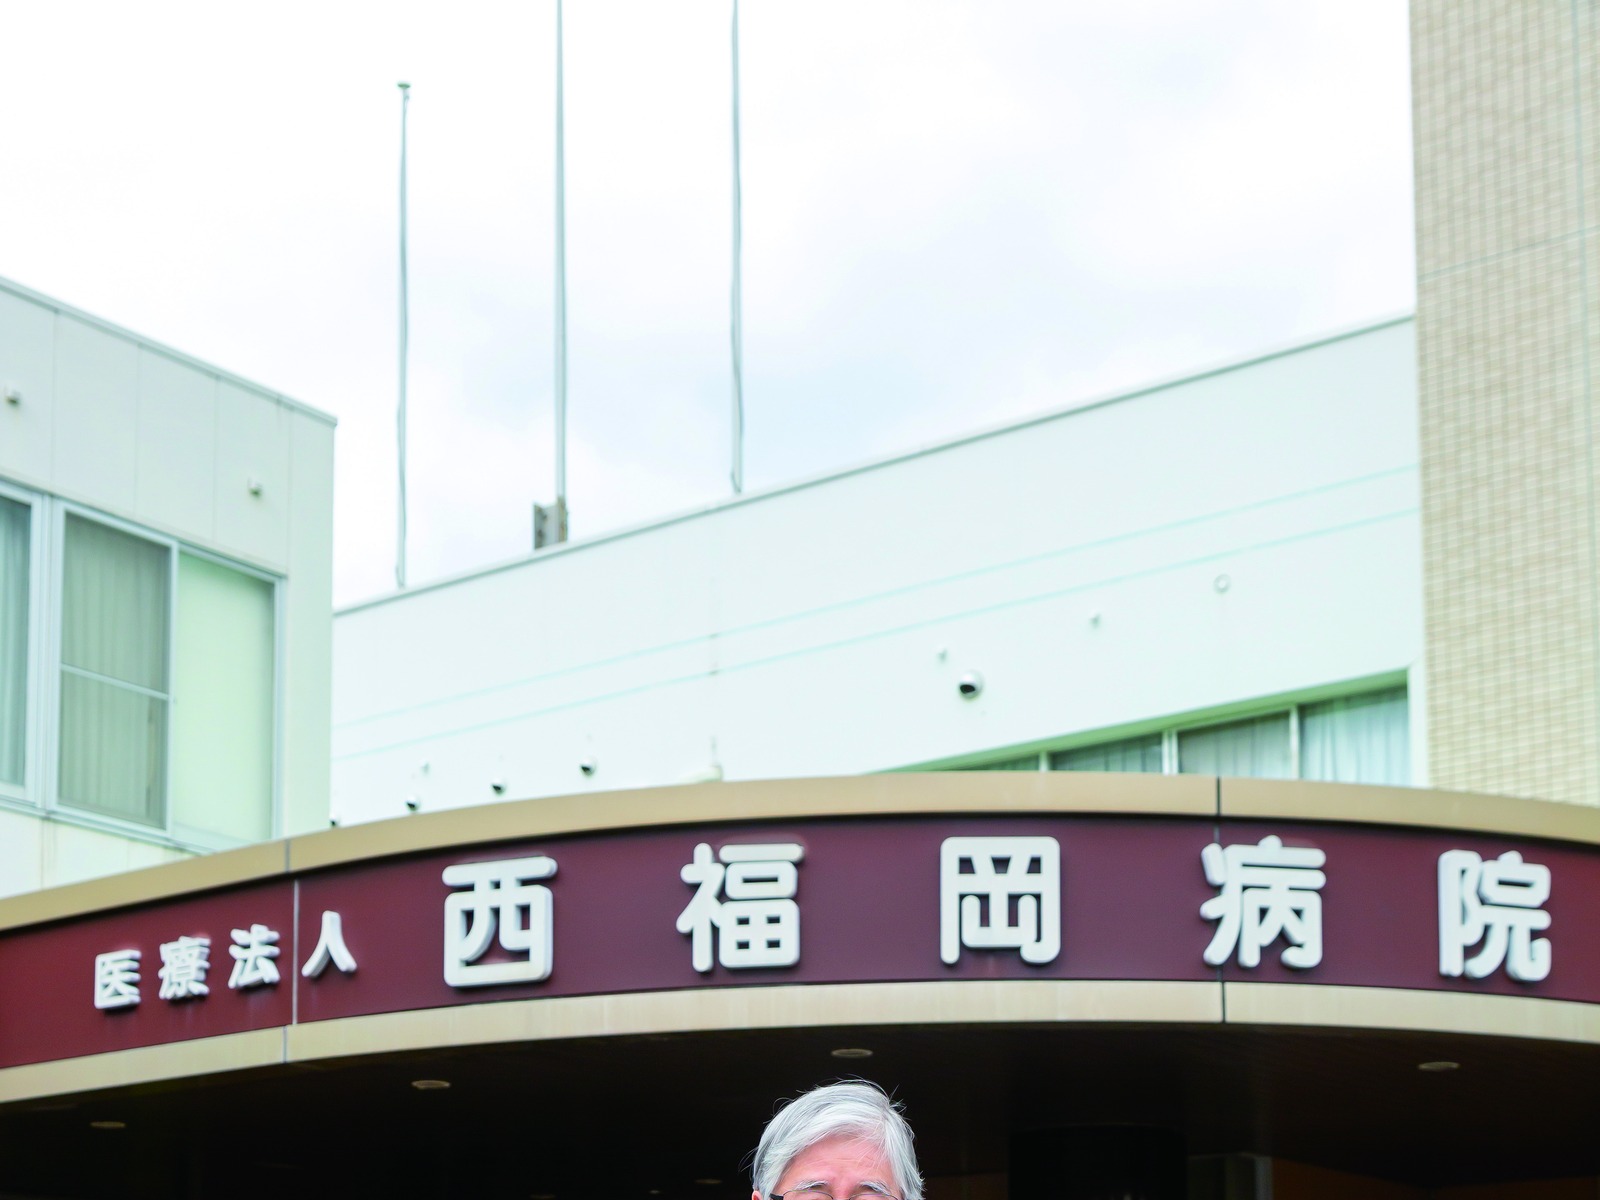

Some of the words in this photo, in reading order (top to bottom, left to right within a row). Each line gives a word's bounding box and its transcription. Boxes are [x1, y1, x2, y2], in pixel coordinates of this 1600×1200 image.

[94, 910, 357, 1010] 医療法人
[441, 835, 1552, 989] 西福岡病院
